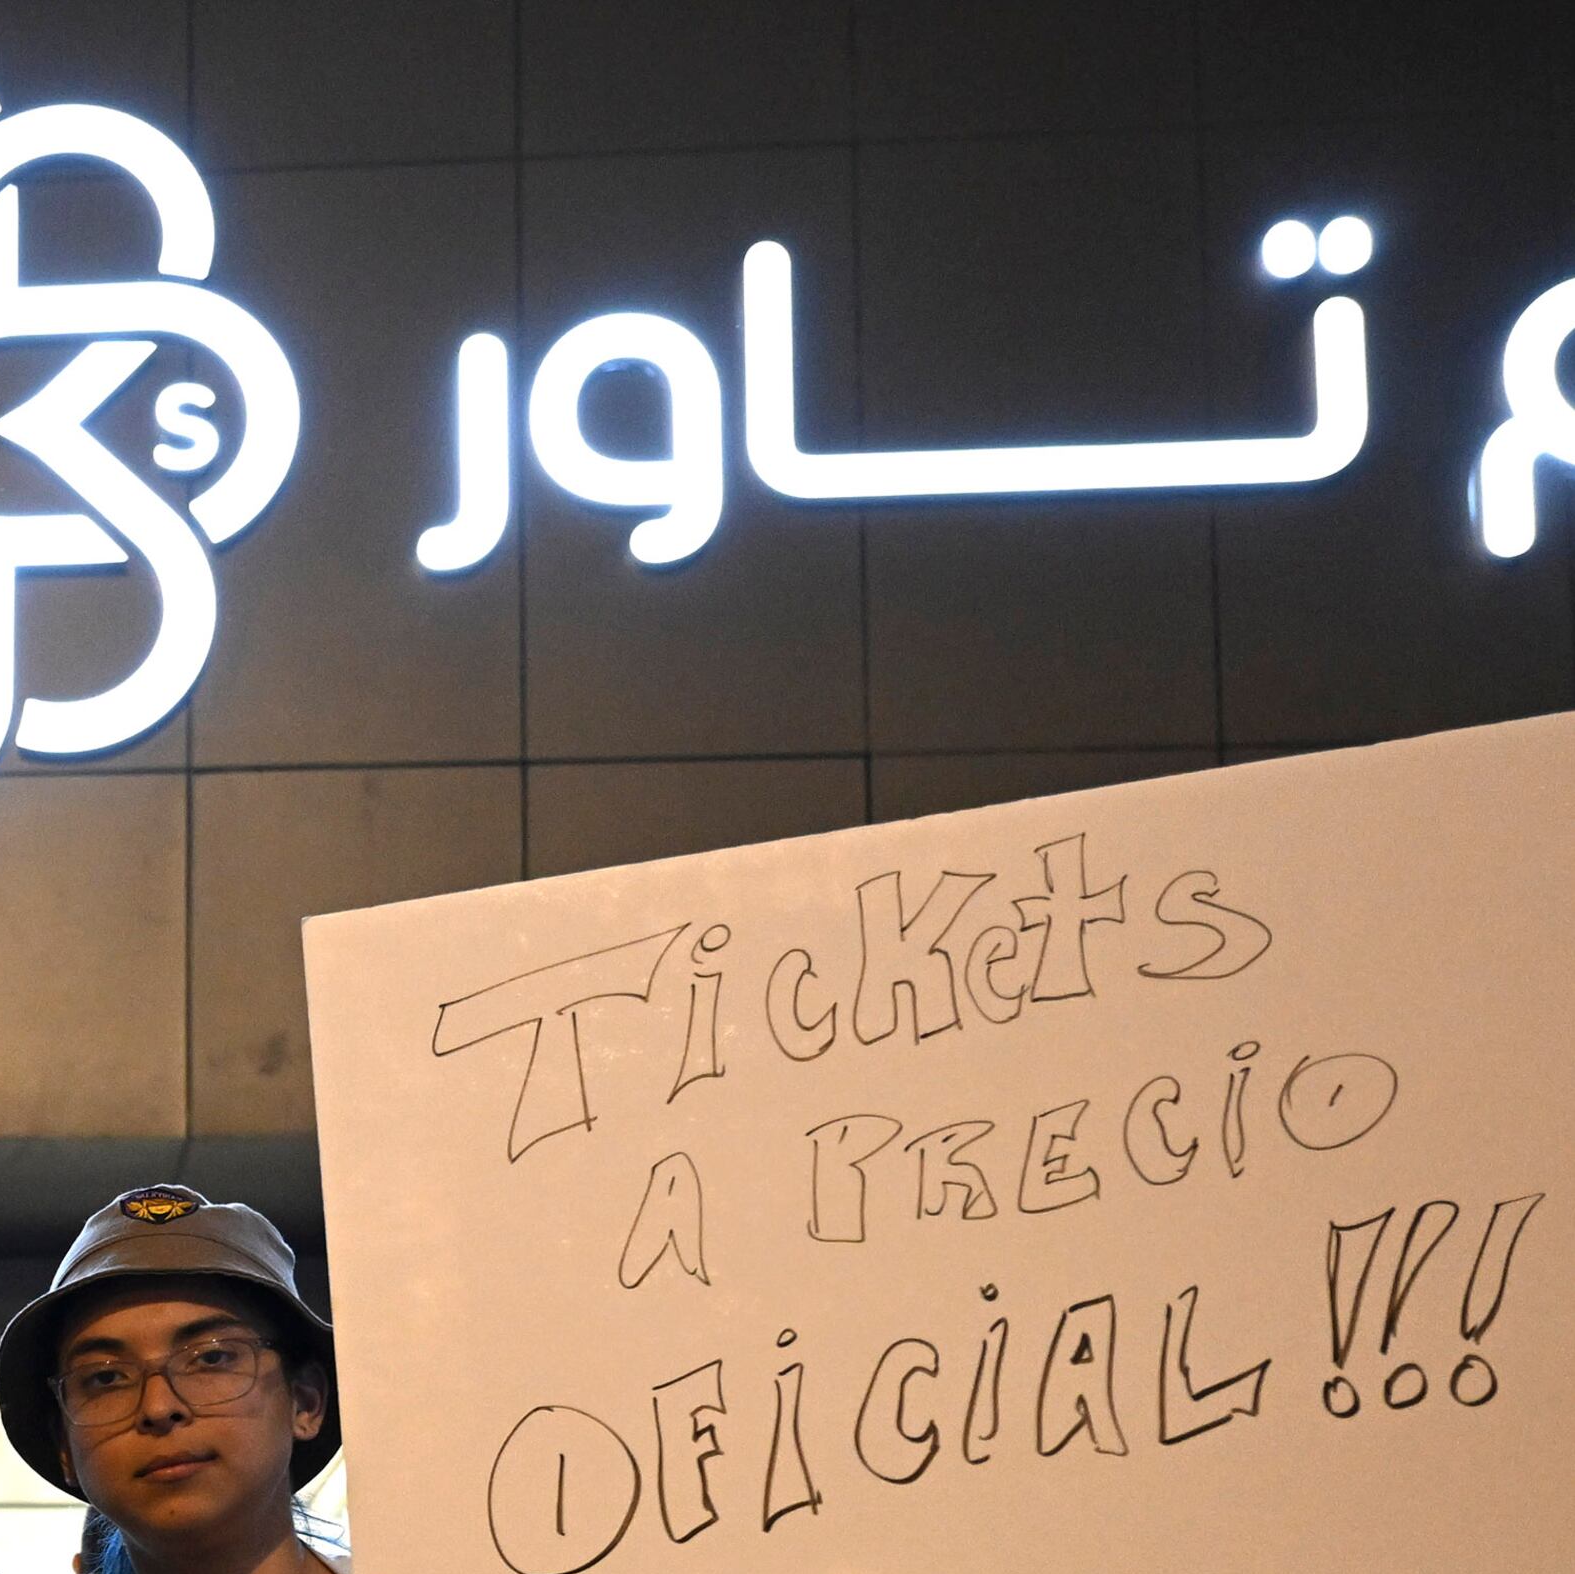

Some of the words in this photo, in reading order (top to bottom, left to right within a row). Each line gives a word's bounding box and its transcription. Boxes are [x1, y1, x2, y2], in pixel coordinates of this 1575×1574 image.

[152, 381, 221, 473] S
[415, 215, 1373, 572] تاور
[618, 1150, 710, 1289] A
